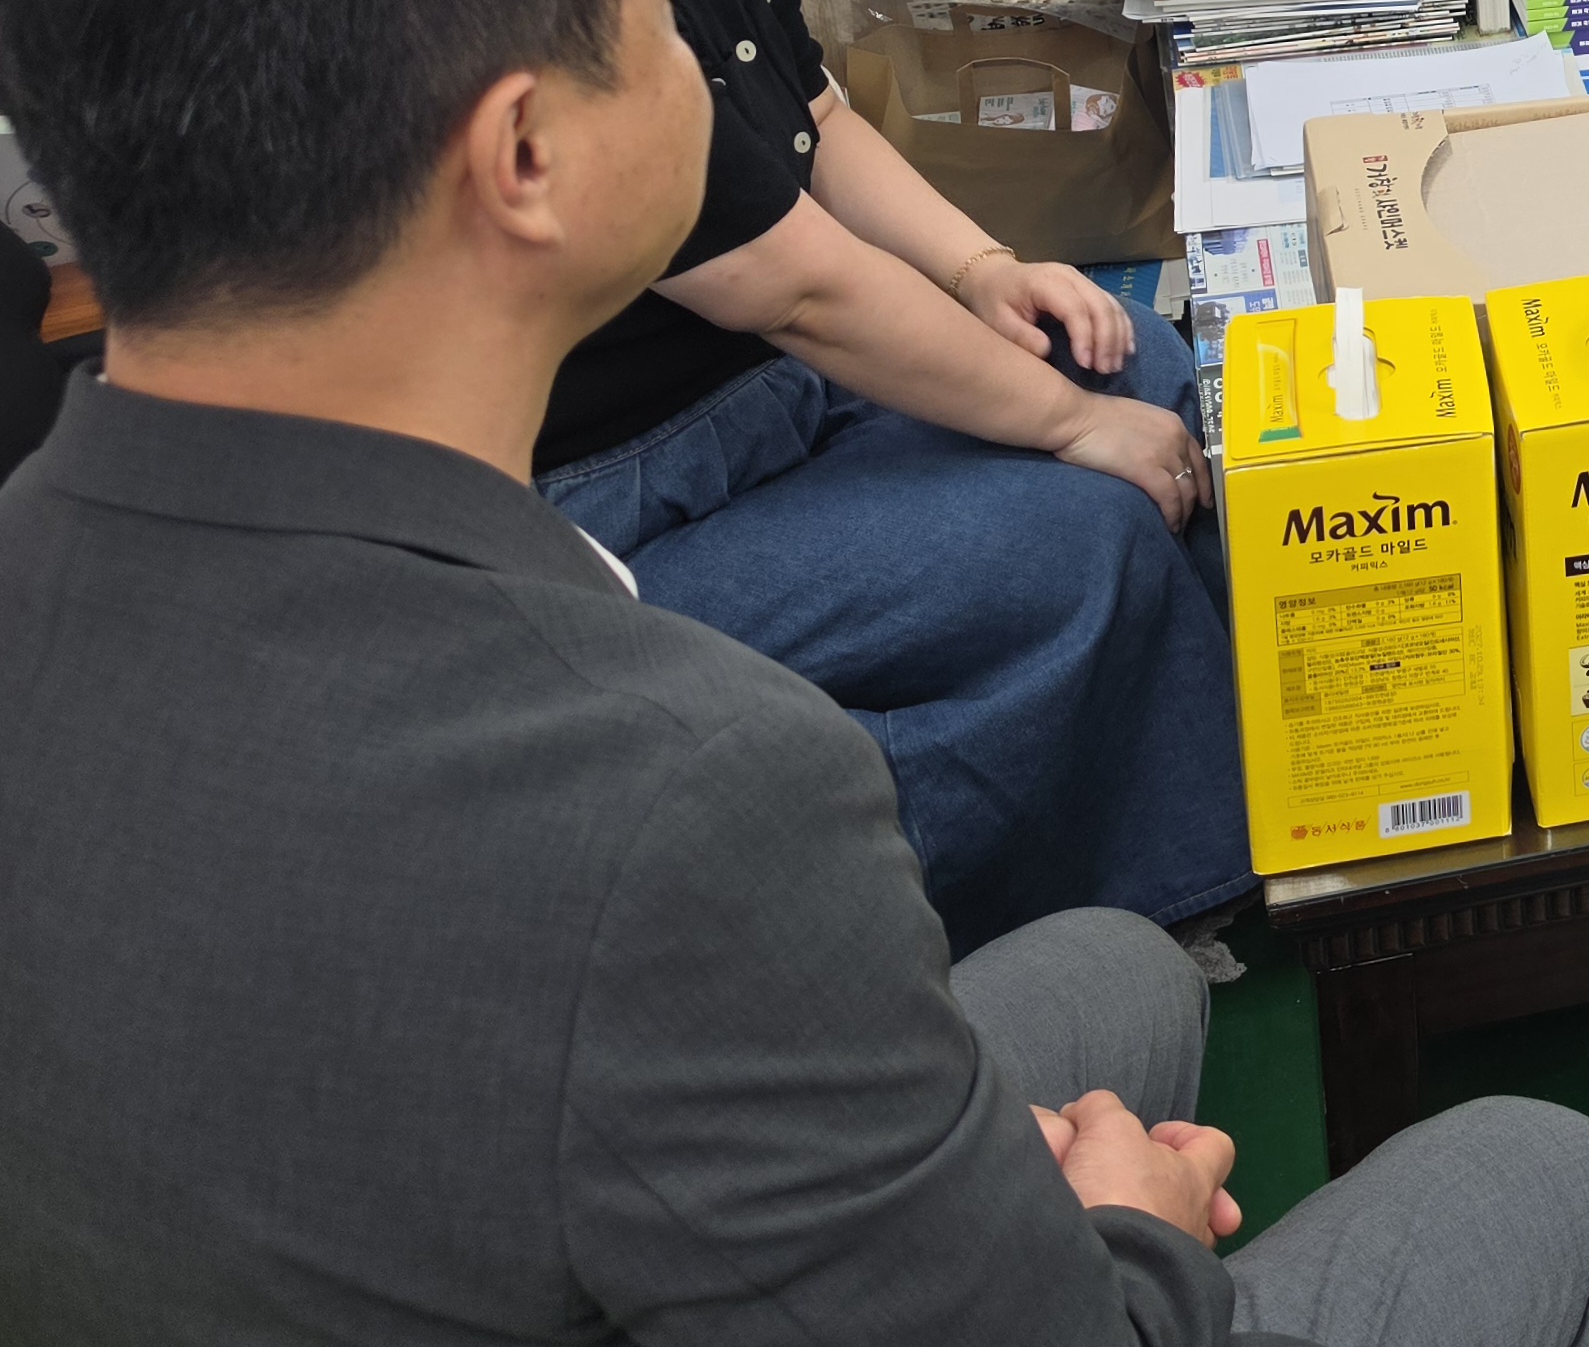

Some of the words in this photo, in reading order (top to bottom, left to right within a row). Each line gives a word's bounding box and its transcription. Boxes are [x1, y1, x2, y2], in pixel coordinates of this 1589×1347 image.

[1375, 198, 1409, 251] 샤인머스켓
[1521, 297, 1549, 339] Maxim
[1430, 378, 1457, 418] Maxim
[1282, 491, 1451, 546] Maxim
[1309, 545, 1375, 564] 모카골드
[1381, 538, 1428, 555] 마일드
[1350, 560, 1388, 572] 커피믹스
[1278, 596, 1317, 609] 영양정보
[1311, 820, 1367, 837] 동서식품
